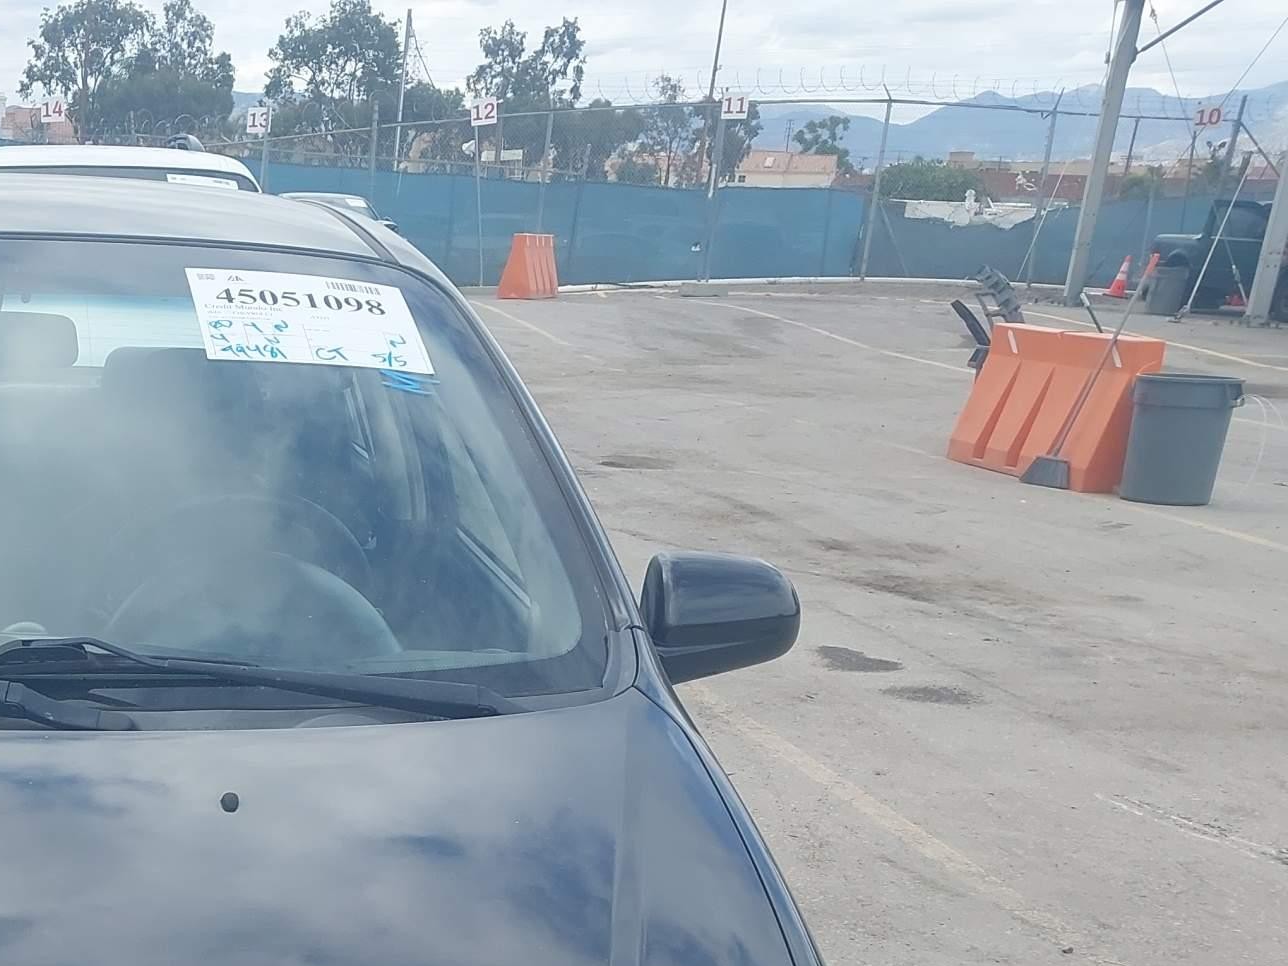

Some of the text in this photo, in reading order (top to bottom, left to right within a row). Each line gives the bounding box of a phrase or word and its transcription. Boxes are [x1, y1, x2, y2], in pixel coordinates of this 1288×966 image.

[42, 100, 63, 117] 14
[473, 102, 495, 121] 12
[723, 96, 746, 114] 11
[248, 112, 267, 128] 13
[1195, 108, 1221, 126] 10
[215, 287, 386, 317] 45051098
